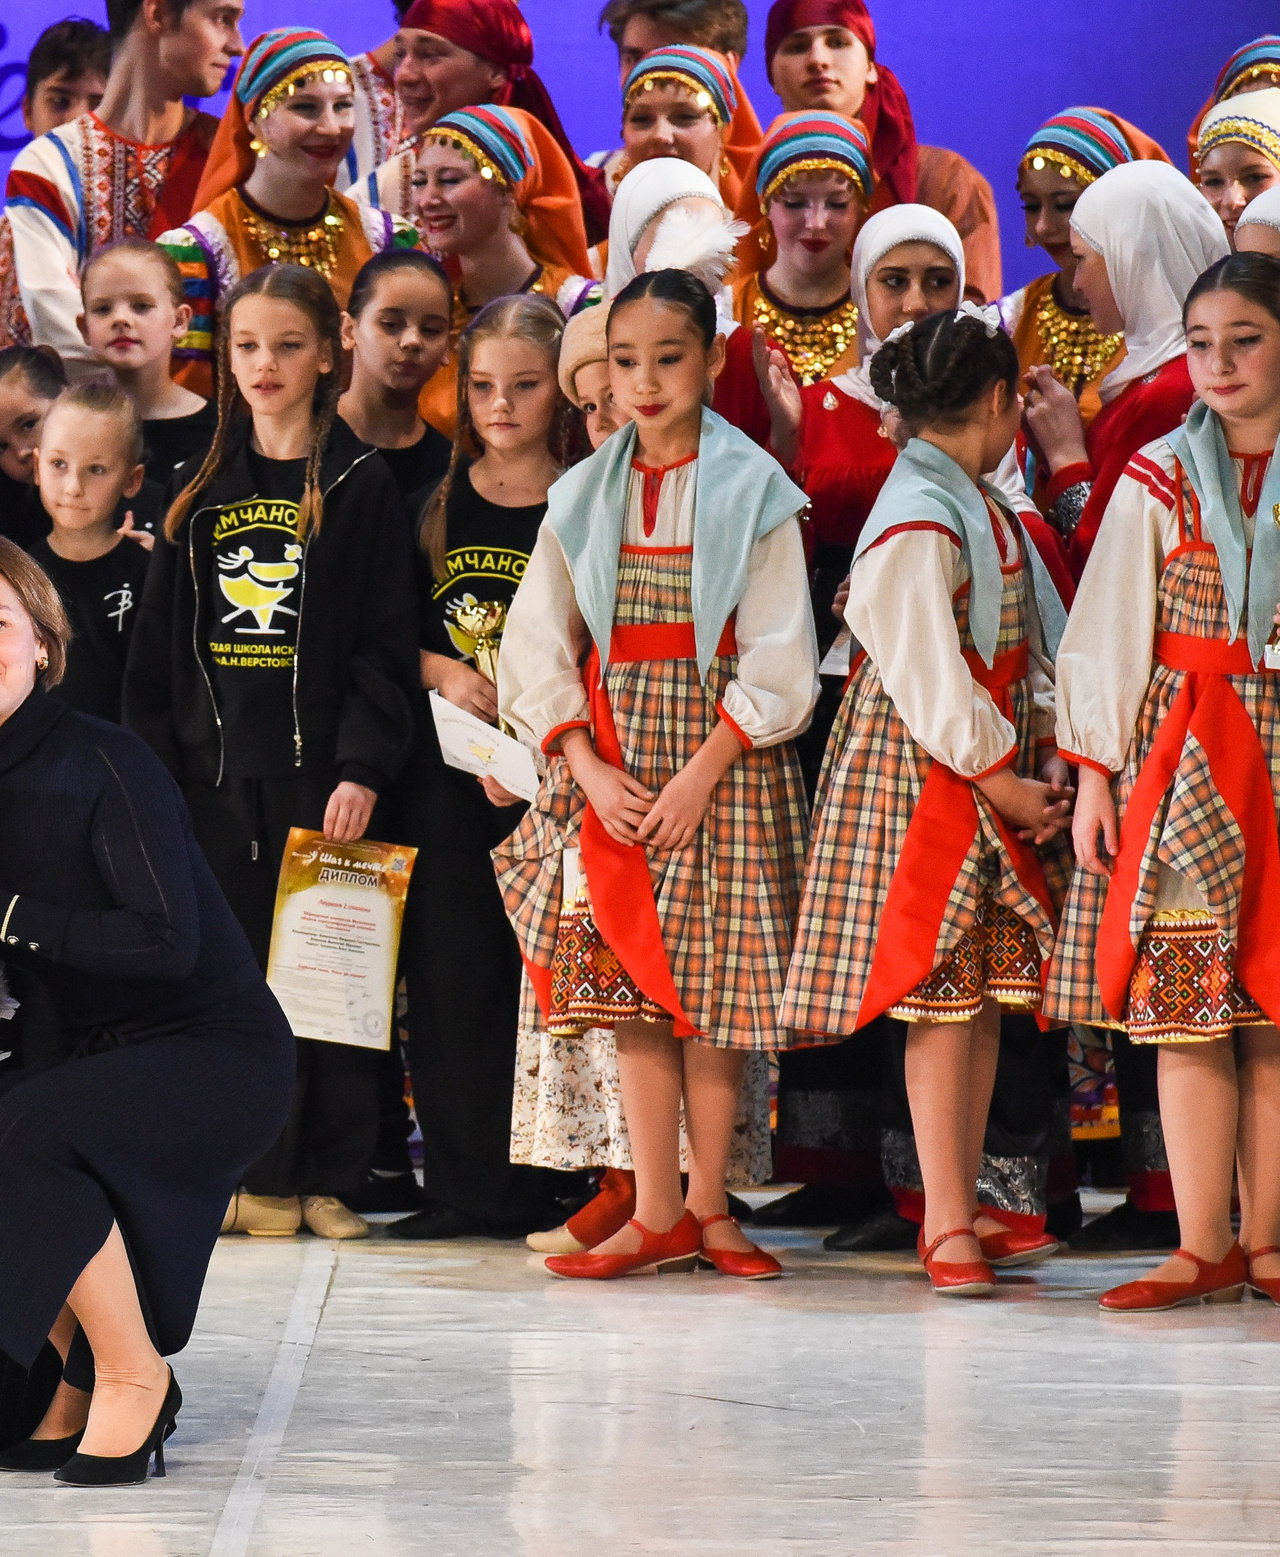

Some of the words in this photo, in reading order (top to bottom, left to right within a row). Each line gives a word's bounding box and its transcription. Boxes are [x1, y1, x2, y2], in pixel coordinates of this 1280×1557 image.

[233, 644, 271, 654] ШКОЛА
[319, 852, 342, 865] Шаг
[319, 869, 378, 887] ДИПЛОМ
